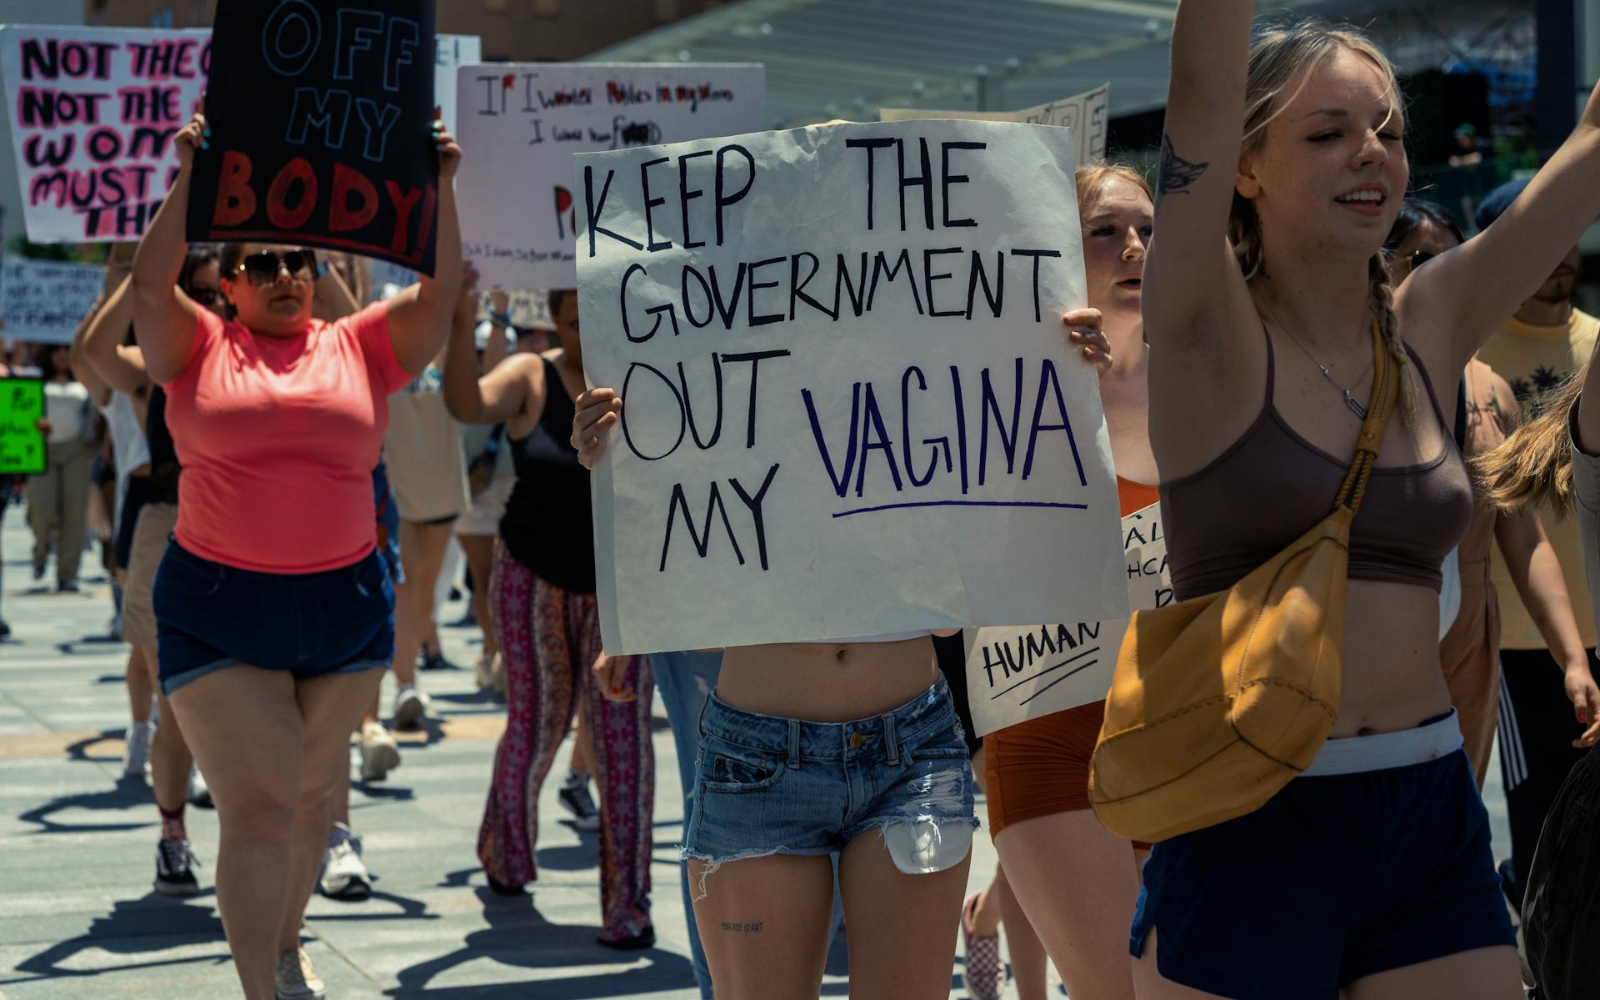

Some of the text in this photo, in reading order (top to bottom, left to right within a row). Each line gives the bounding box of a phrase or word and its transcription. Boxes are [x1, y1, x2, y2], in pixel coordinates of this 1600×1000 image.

[20, 38, 119, 80] NOT
[126, 38, 198, 79] THE
[262, 0, 419, 91] OFF
[18, 86, 112, 129] NOT
[118, 86, 181, 126] THE
[23, 126, 180, 167] WOM
[286, 87, 401, 162] MY
[30, 164, 156, 210] MUST
[213, 150, 437, 252] BODY!
[583, 137, 988, 258] KEEP THE
[620, 247, 1062, 344] GOVERNMENT
[620, 349, 791, 461] OUT
[801, 357, 1088, 497] VAGINA
[659, 462, 781, 572] MY
[982, 622, 1101, 687] HUMAN
